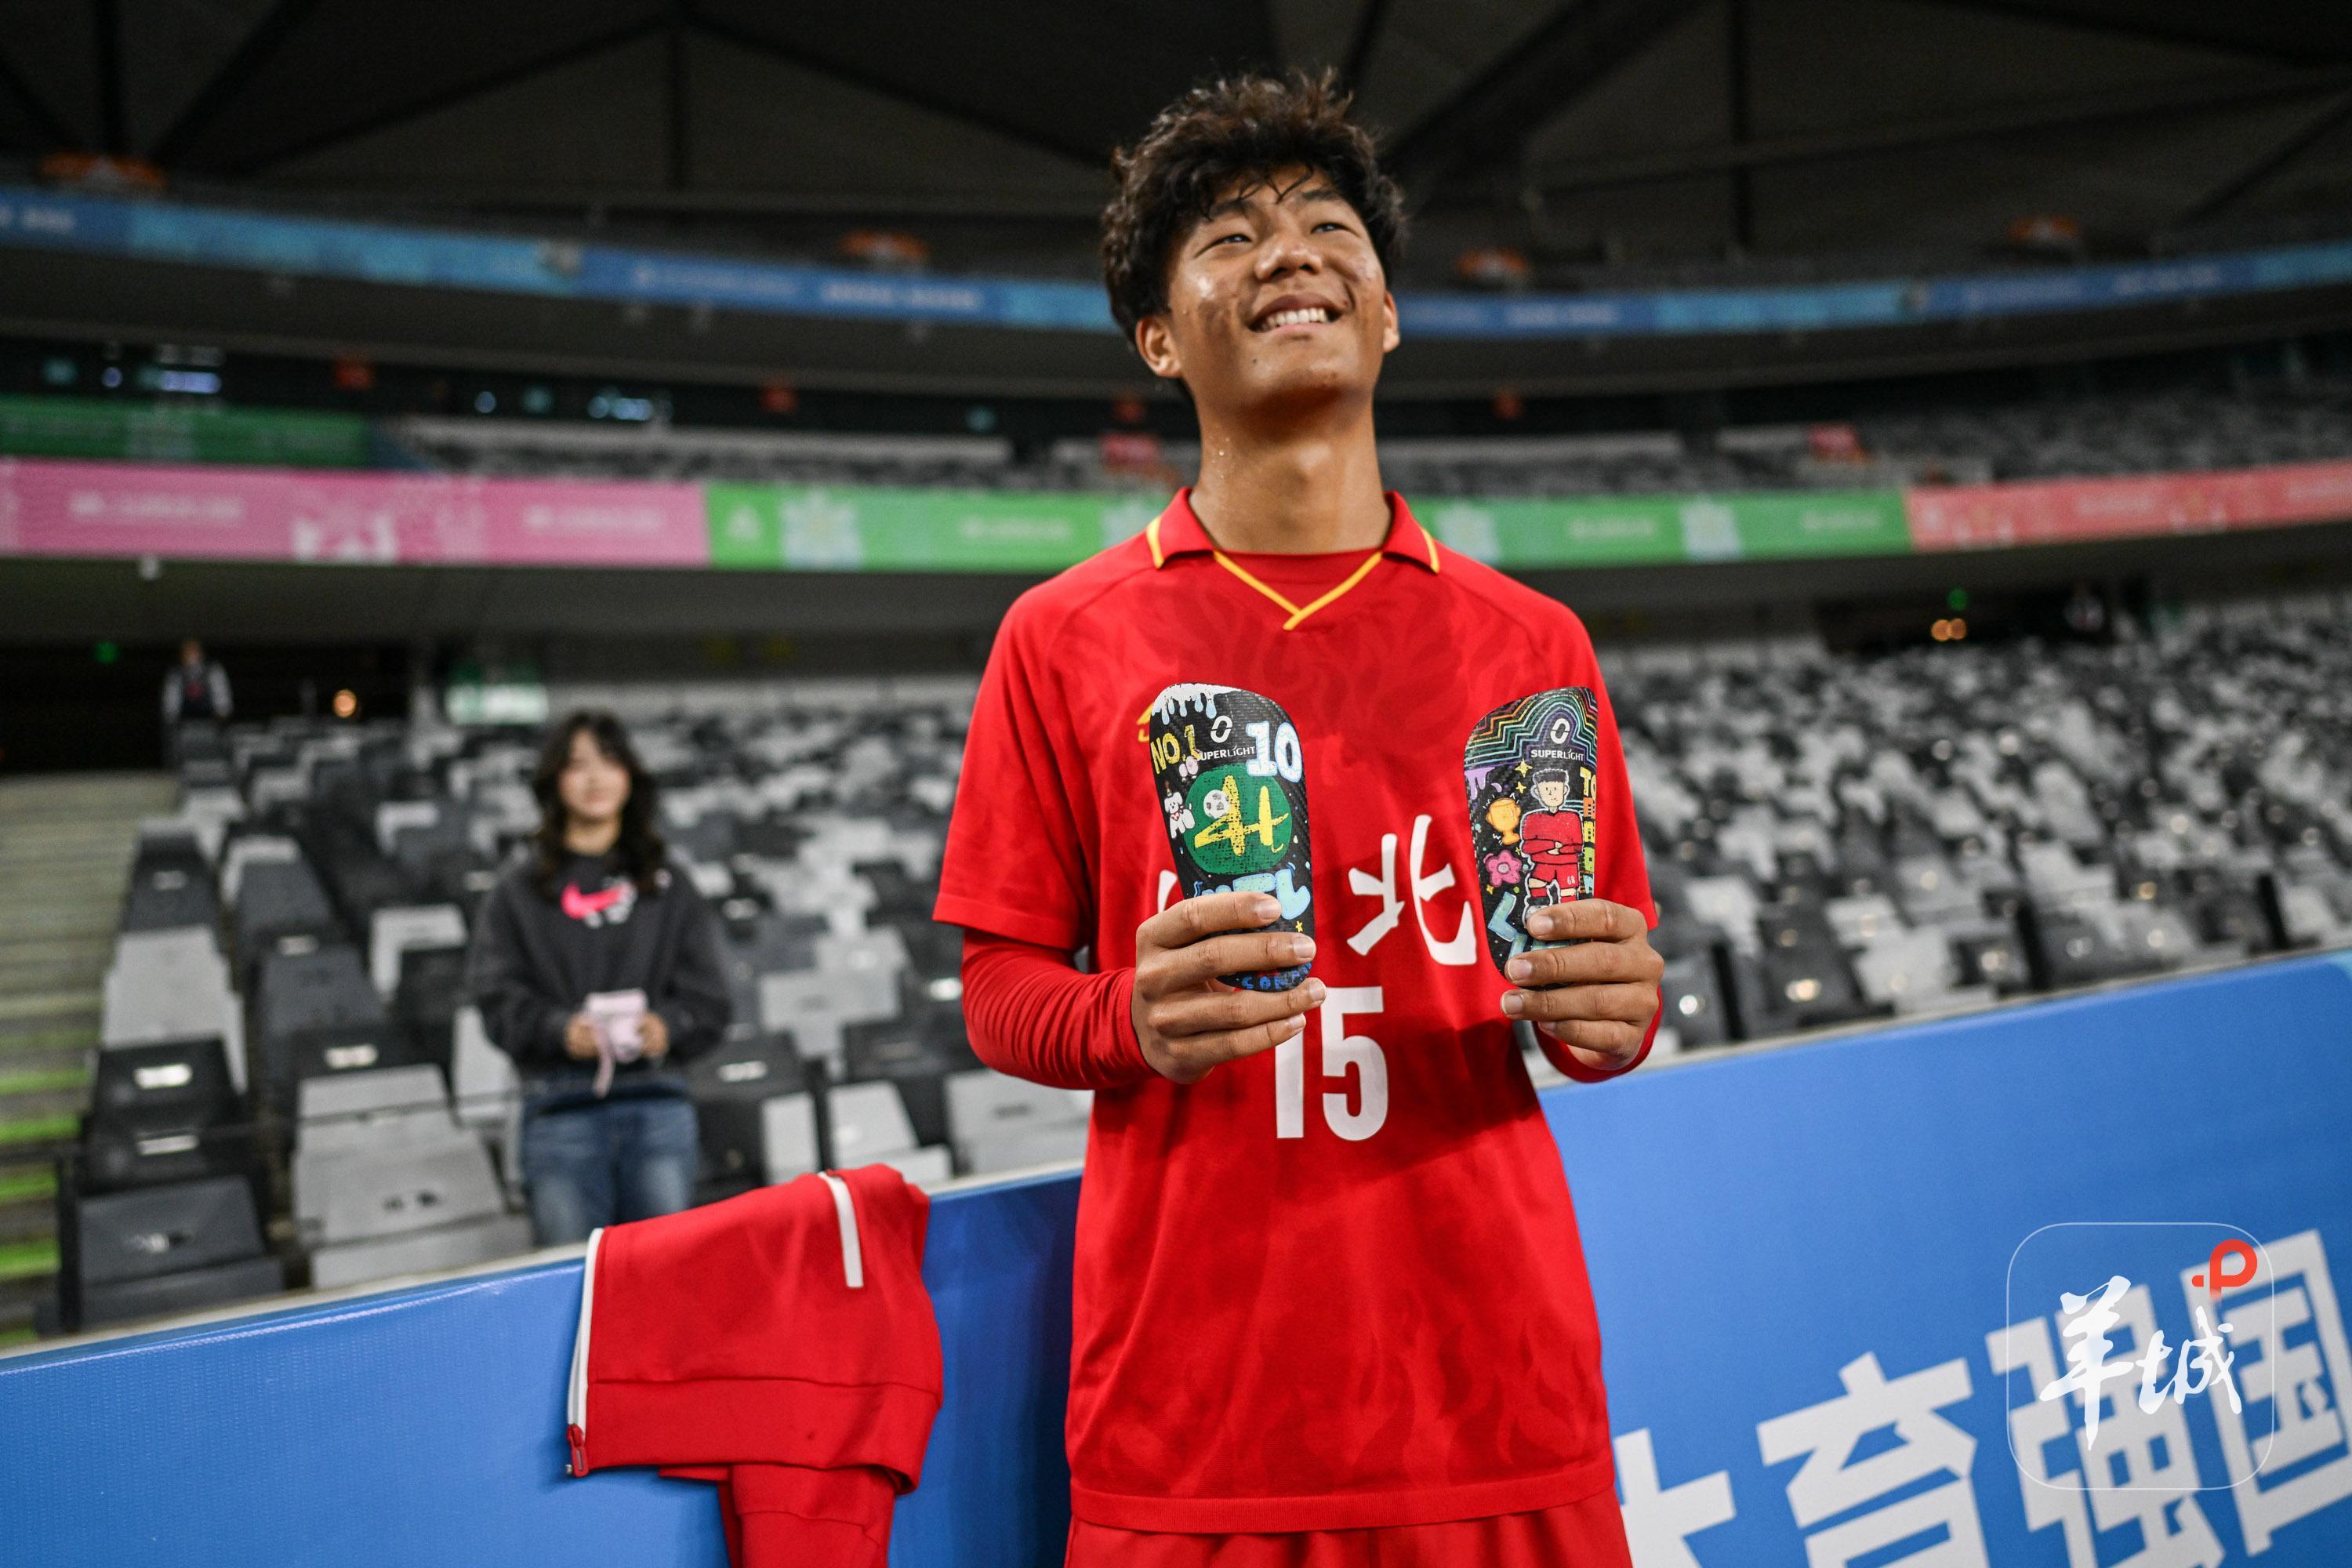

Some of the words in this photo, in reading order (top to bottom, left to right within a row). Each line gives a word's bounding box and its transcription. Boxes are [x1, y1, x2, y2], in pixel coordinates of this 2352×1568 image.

[1150, 724, 1203, 775] NO.1
[1245, 720, 1303, 783] 10
[1530, 748, 1584, 761] SUPERLIGHT
[1274, 985, 1388, 1142] 15
